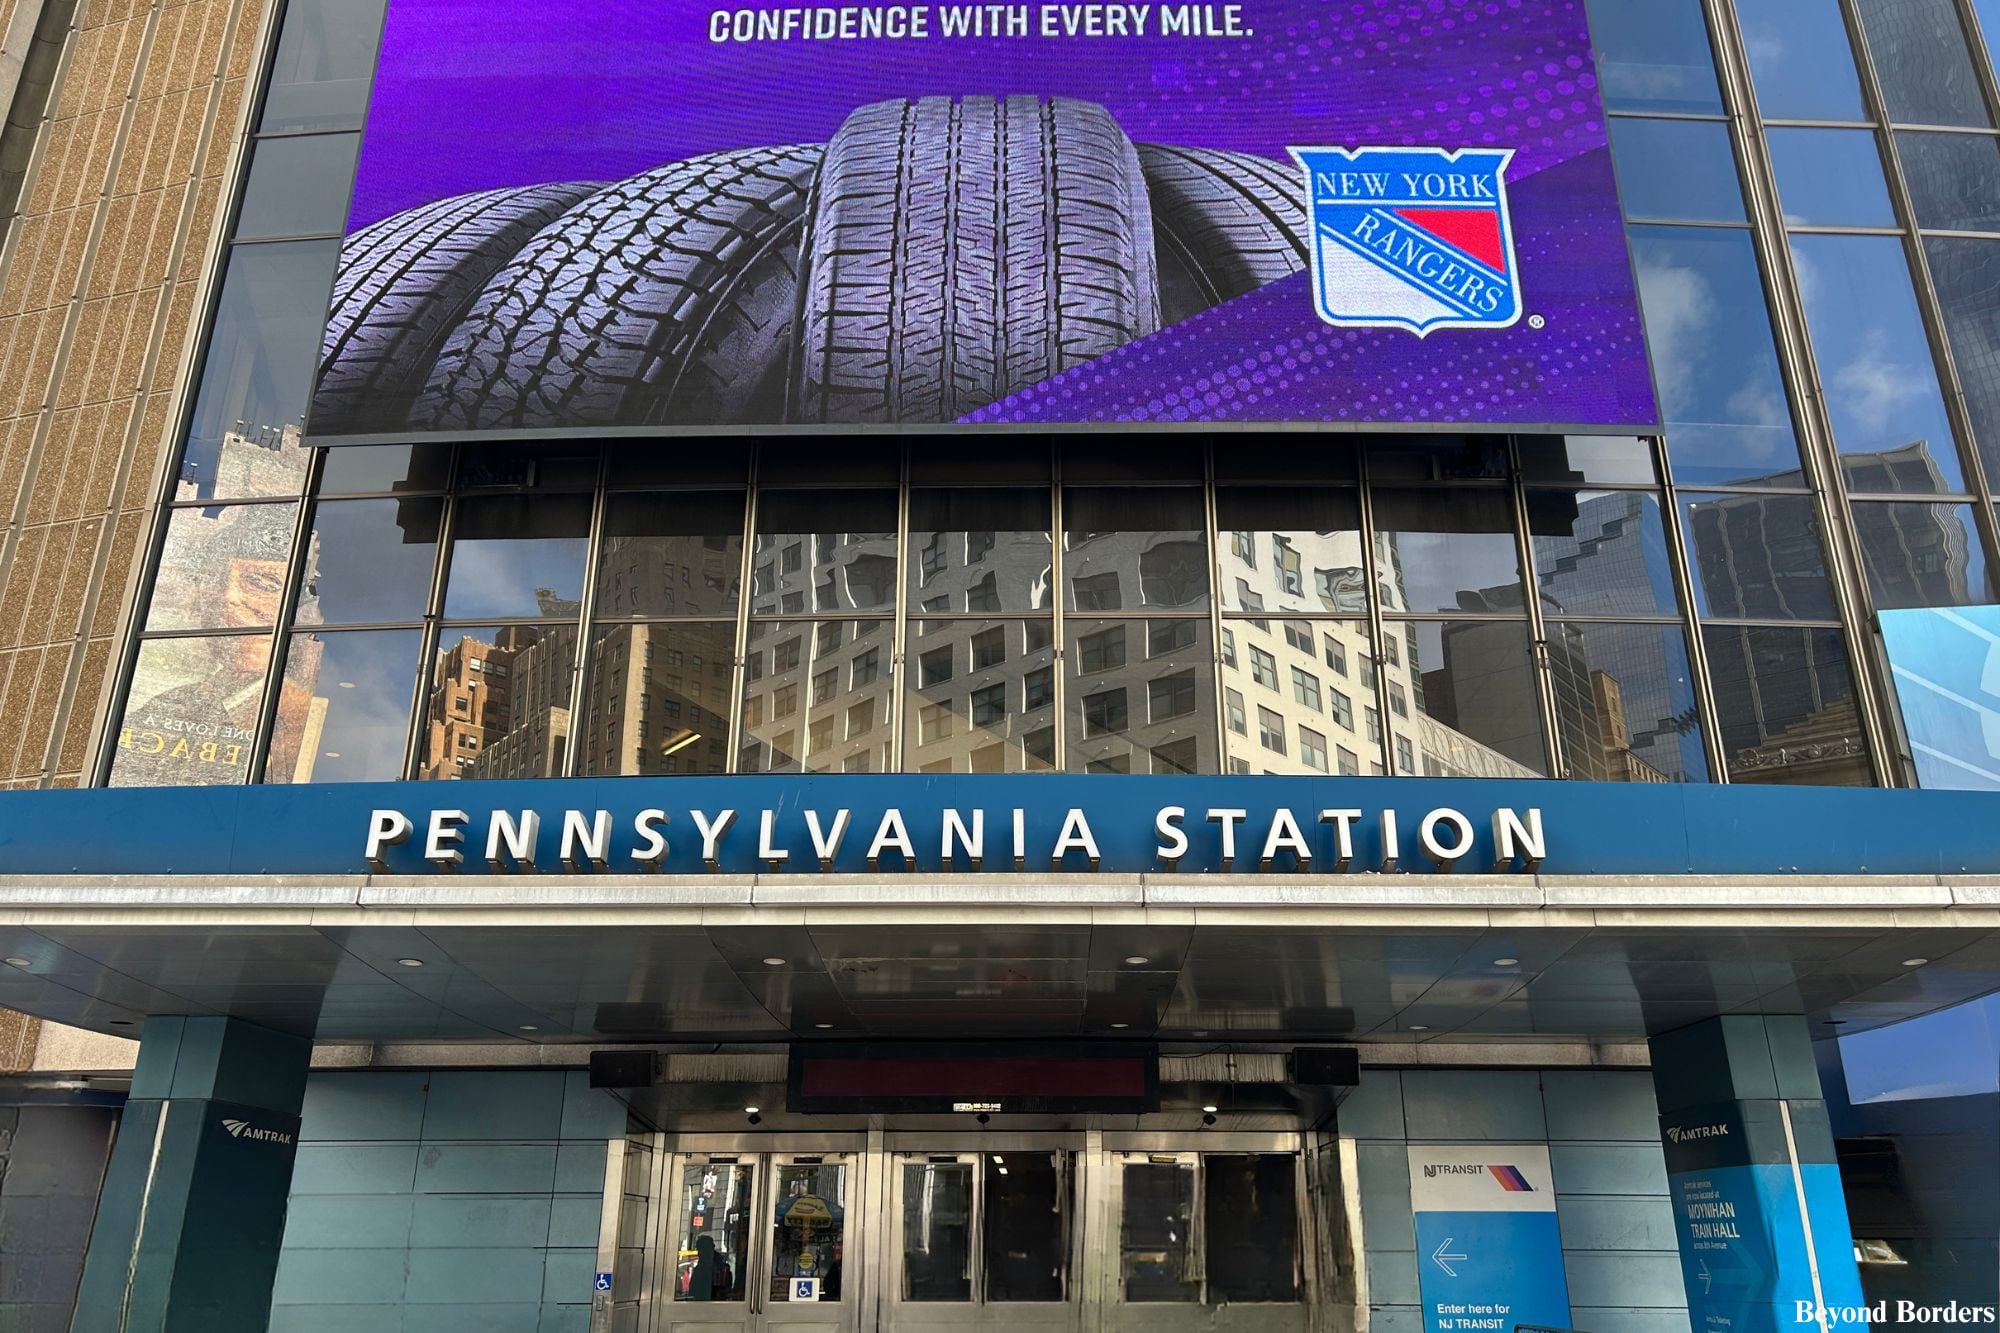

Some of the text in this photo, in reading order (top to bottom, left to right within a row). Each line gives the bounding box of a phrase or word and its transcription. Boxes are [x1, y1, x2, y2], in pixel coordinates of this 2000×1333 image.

[709, 4, 1254, 42] CONFIDENCE WITH EVERY MILE.
[1316, 172, 1496, 198] NEW YORK
[1351, 212, 1504, 313] RANGERS
[365, 806, 1546, 863] PENNSYLVANIA STATION
[243, 1127, 292, 1144] AMTRAK
[1680, 1123, 1729, 1141] AMTRAK
[1687, 1202, 1736, 1219] MOYNIHAN
[1690, 1222, 1741, 1238] TRAIN HALL
[1437, 1303, 1510, 1314] Enter here for
[1438, 1319, 1504, 1329] NJ TRANSIT
